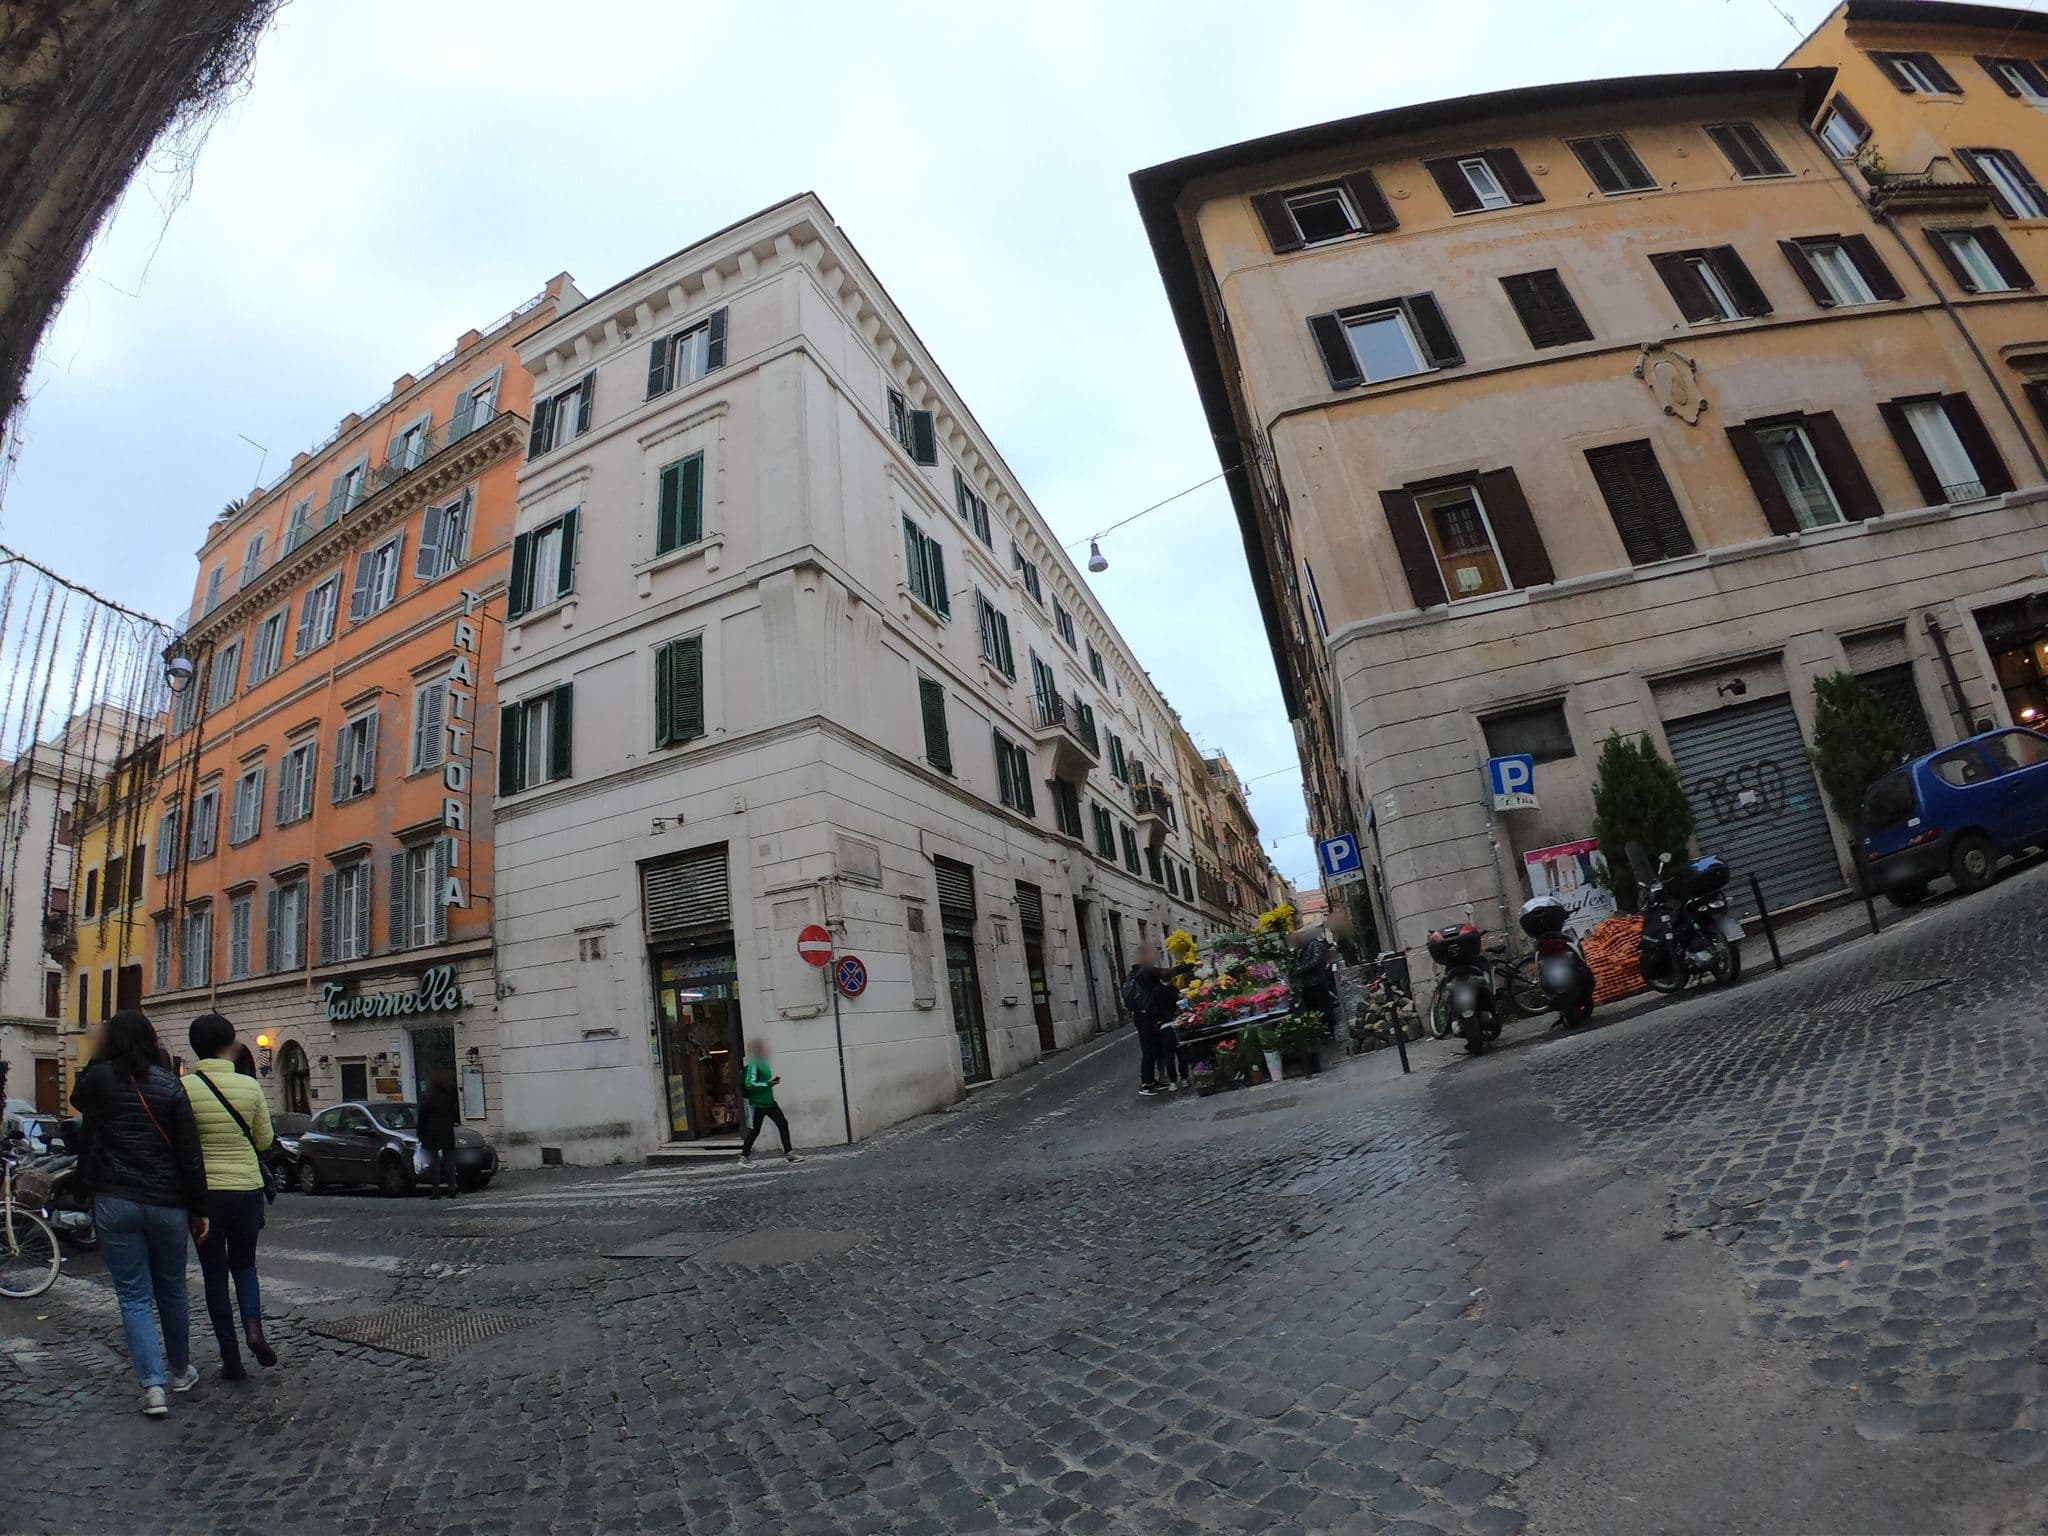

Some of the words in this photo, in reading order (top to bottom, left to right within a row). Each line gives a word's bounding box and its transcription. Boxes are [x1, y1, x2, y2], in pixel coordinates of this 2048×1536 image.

[441, 588, 481, 908] TRATTORIA
[1499, 760, 1529, 794] P
[1327, 840, 1350, 871] P
[321, 966, 460, 1021] Tavernelle
